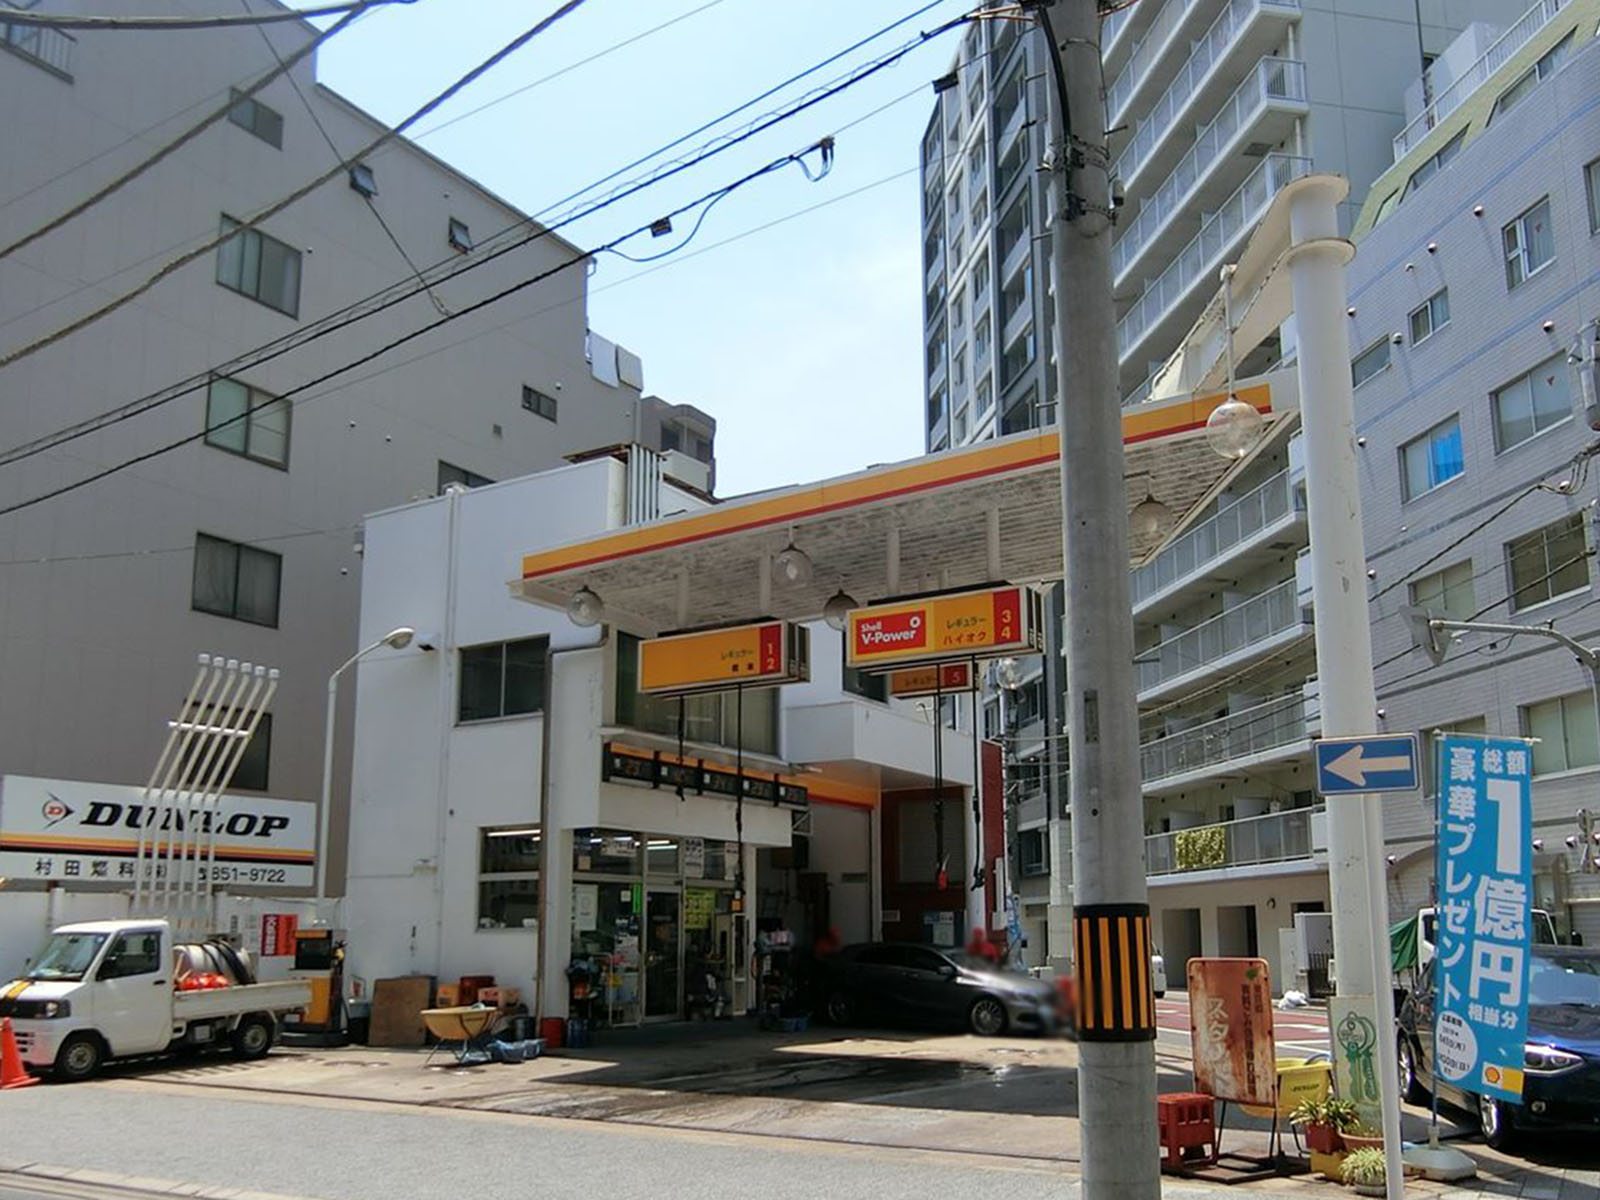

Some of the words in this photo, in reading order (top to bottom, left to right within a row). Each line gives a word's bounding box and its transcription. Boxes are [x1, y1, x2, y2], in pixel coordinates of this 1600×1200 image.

[1001, 609, 1012, 624] 3
[861, 621, 882, 632] Shell
[1001, 625, 1011, 639] 4
[862, 630, 916, 645] V-Power
[943, 631, 987, 646] ハイオク
[767, 642, 774, 656] 1
[767, 657, 776, 671] 2
[951, 671, 961, 684] 5
[1482, 748, 1527, 775] 総額
[80, 801, 290, 838] DUNLOP
[1441, 746, 1477, 1008] 豪華プレゼント
[1468, 1002, 1519, 1030] 相当分
